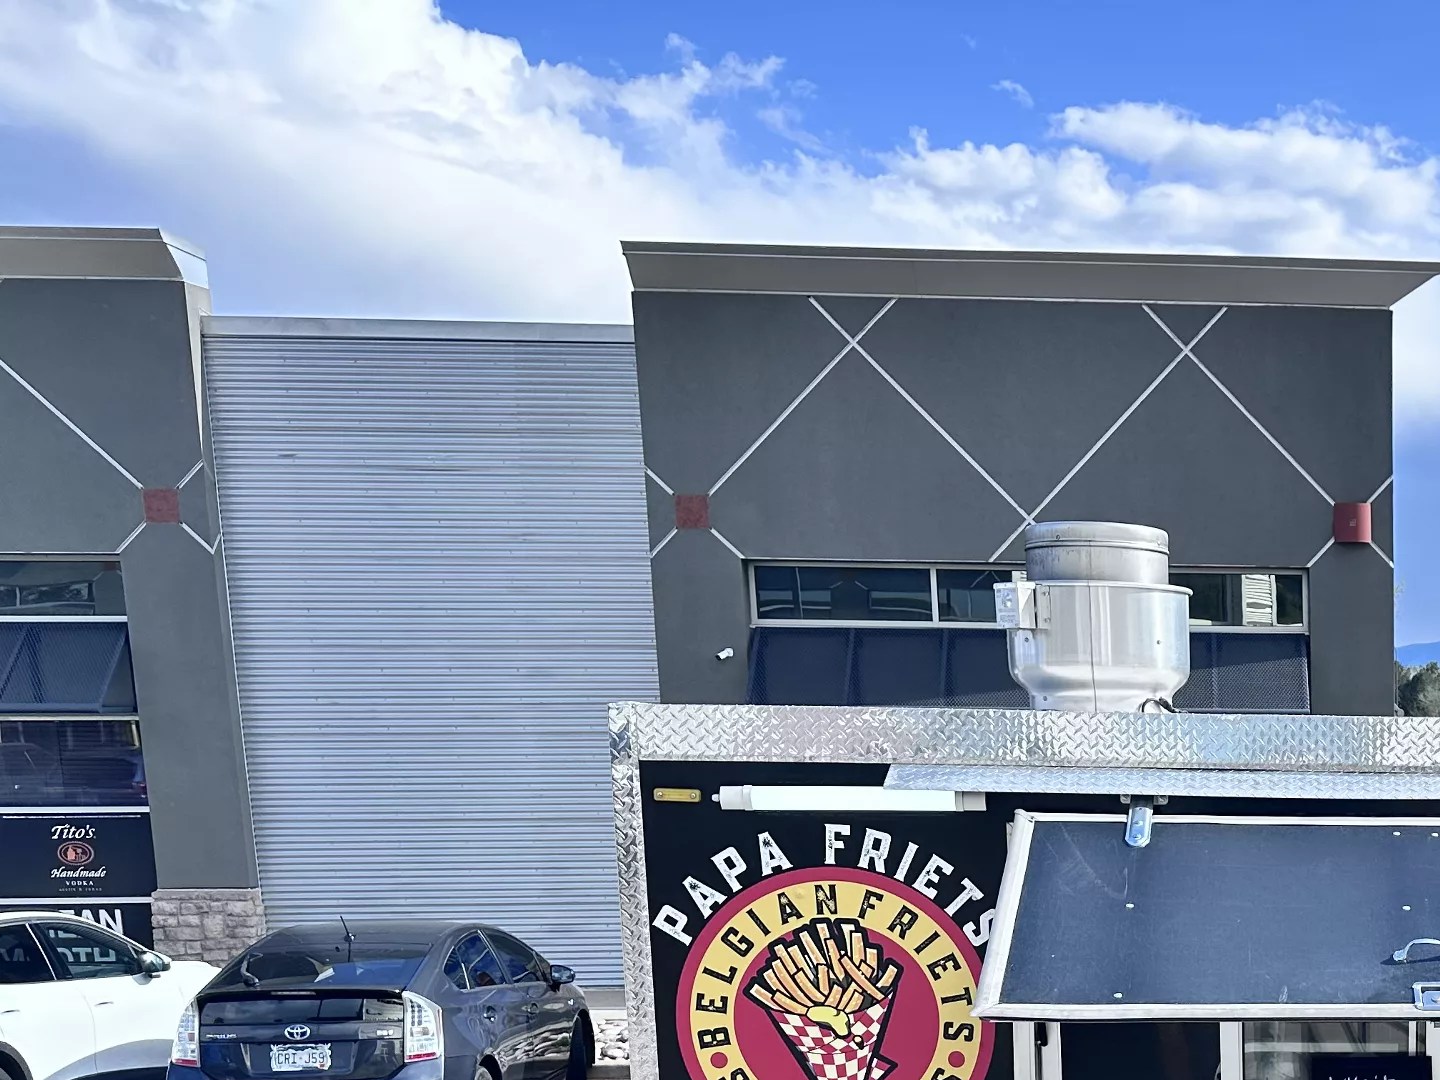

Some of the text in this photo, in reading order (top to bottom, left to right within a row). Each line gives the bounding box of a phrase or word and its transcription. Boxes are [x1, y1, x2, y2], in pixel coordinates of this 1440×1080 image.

[51, 824, 96, 839] Tito's
[50, 866, 107, 878] Handmade
[652, 823, 996, 947] PAPA FRIETS
[695, 884, 975, 1051] BELGIAN FRIETS
